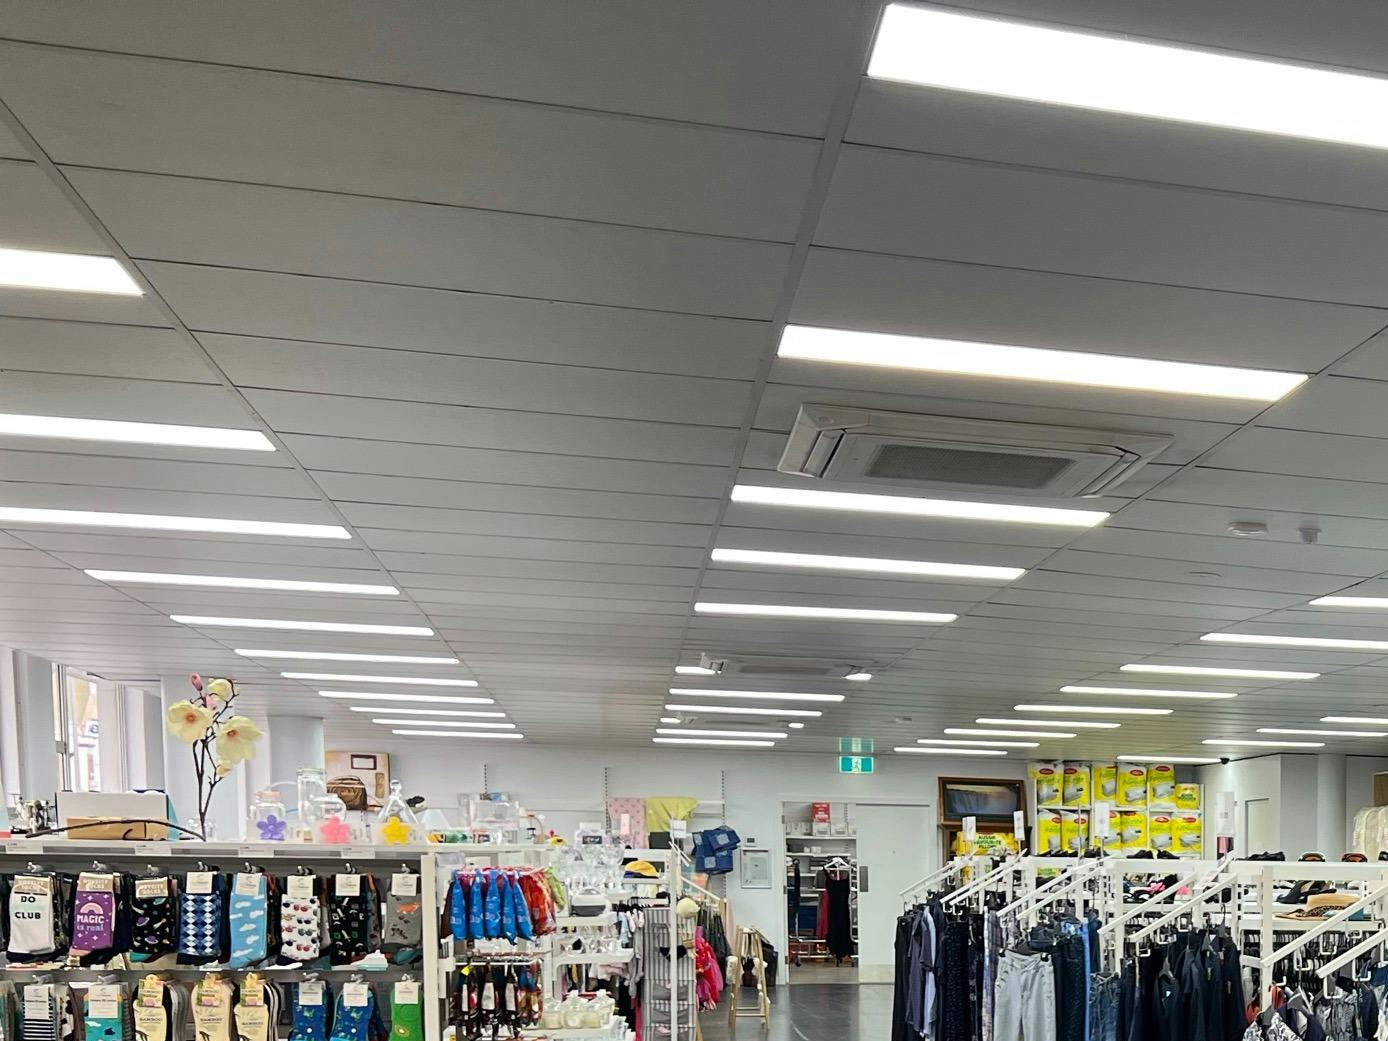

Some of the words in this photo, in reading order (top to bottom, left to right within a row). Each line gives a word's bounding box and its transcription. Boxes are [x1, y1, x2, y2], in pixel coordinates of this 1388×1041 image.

[20, 895, 36, 903] DO
[14, 911, 41, 920] CLUB
[76, 914, 105, 924] MAGIC
